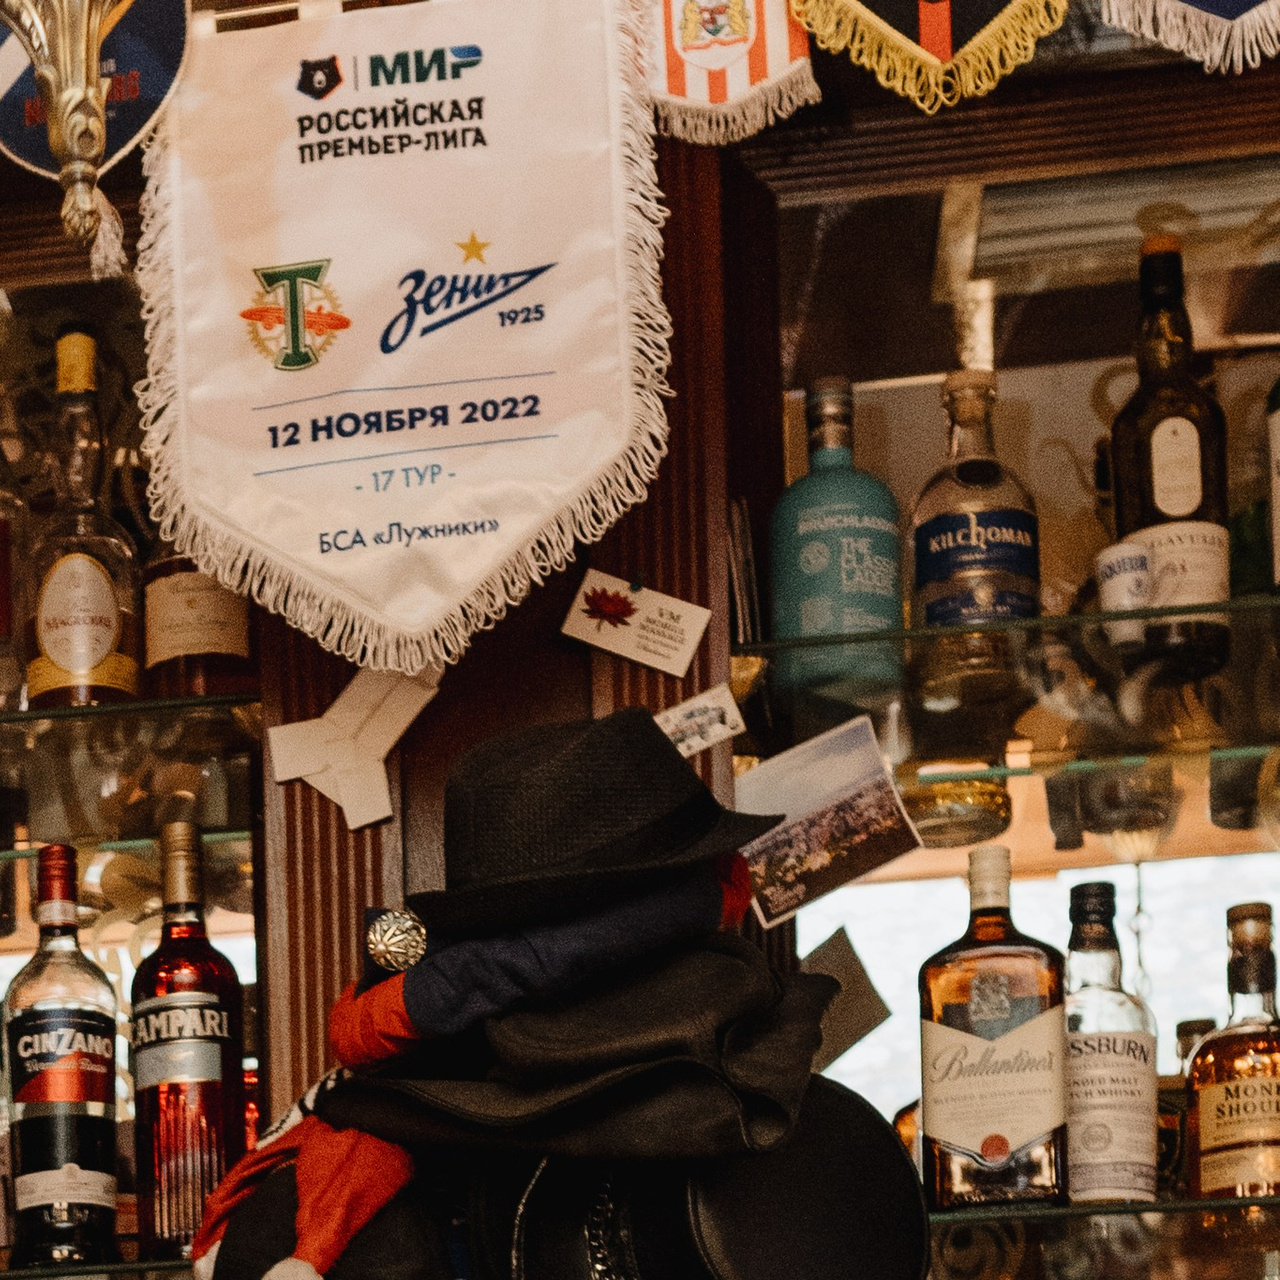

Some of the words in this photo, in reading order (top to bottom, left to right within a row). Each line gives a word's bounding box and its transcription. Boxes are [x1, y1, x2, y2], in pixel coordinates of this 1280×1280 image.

[369, 43, 483, 87] МИР
[297, 96, 485, 138] РОССИЙСКАЯ
[298, 127, 488, 163] ПРЕМЬЕР-ЛИГА
[379, 261, 560, 355] Зенит
[498, 303, 546, 327] 1925
[267, 421, 301, 449] 12
[310, 404, 449, 442] НОЯБРЯ
[459, 394, 541, 426] 2022
[372, 469, 395, 493] 17
[401, 463, 443, 489] ТУР
[318, 528, 368, 555] БСА
[372, 517, 500, 549] «Лужники»
[17, 1027, 113, 1059] CINZANO
[131, 1008, 231, 1049] CAMPARI
[1069, 1036, 1150, 1065] SSBURN
